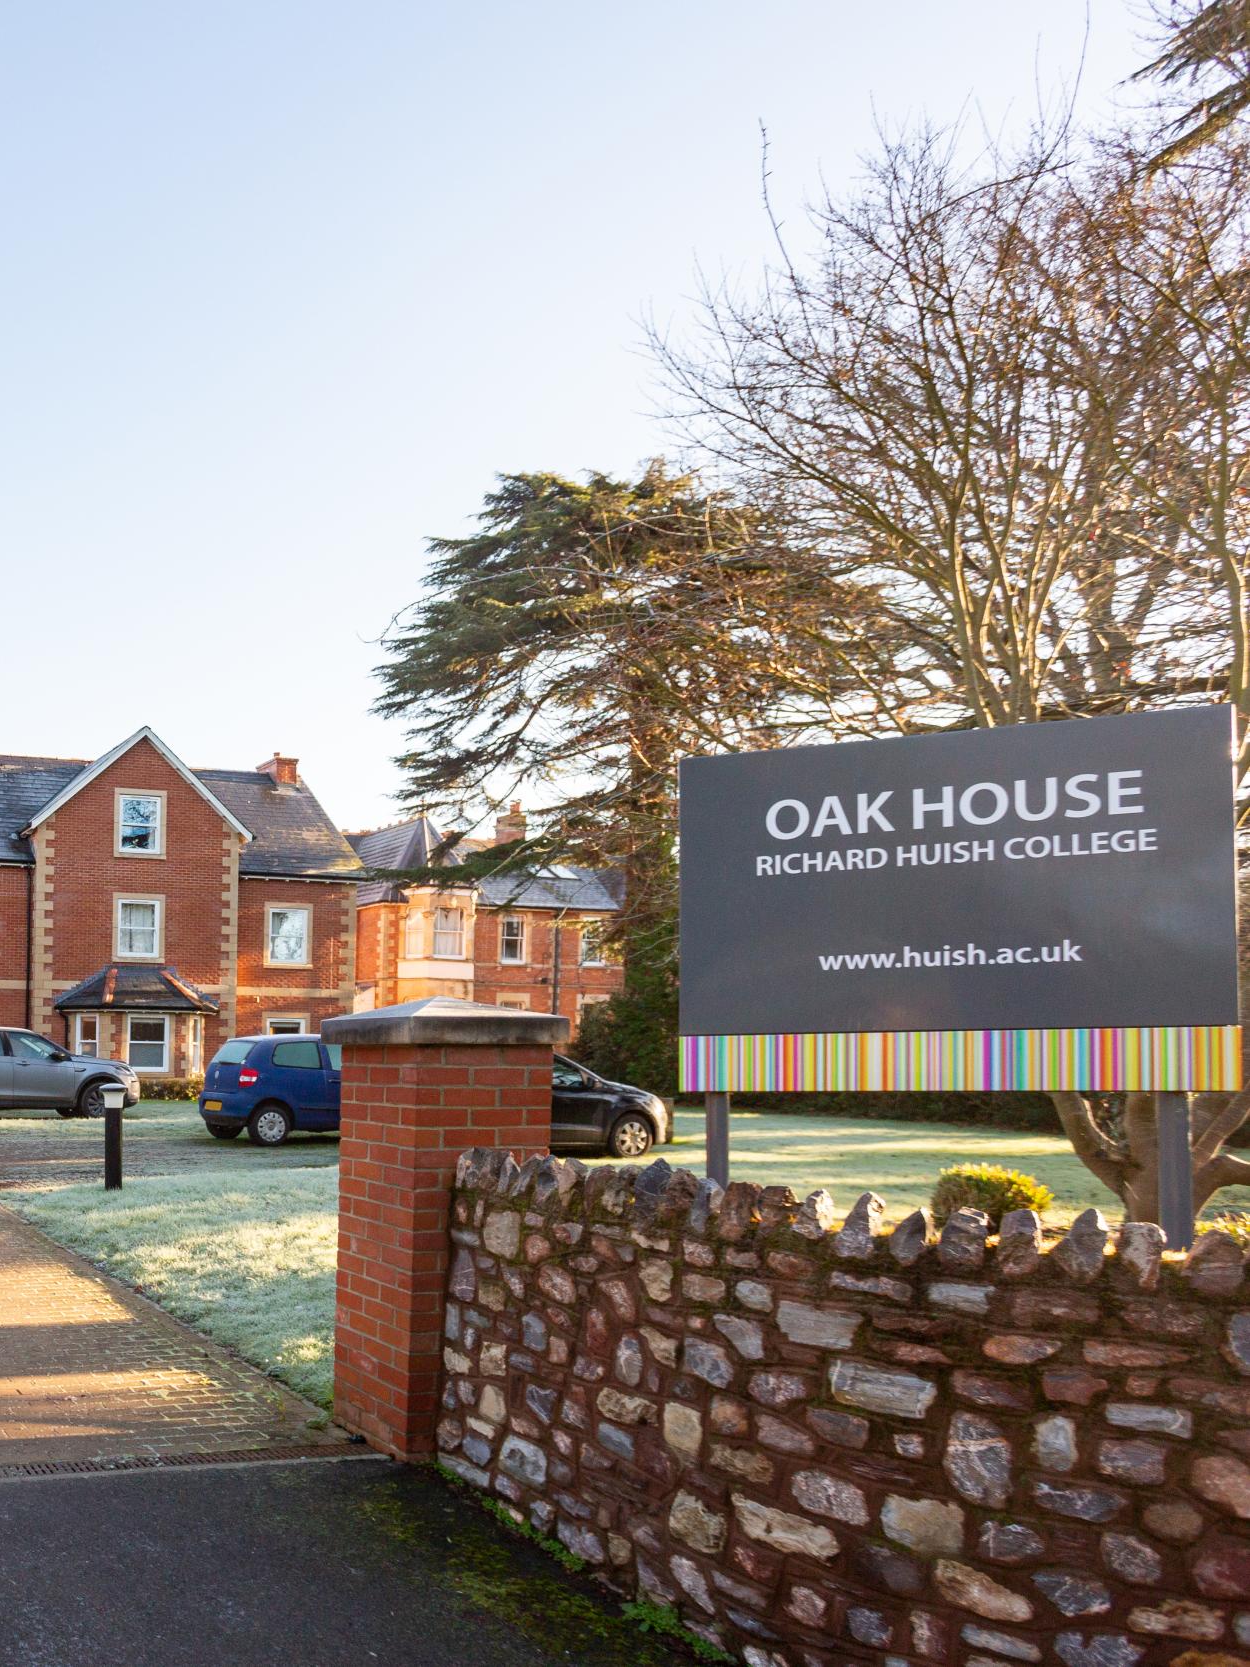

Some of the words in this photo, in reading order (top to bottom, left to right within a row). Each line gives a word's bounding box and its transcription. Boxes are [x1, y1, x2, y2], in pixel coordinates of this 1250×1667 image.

[765, 790, 896, 841] OAK
[912, 769, 1145, 830] HOUSE
[756, 846, 889, 877] RICHARD
[896, 839, 995, 867] HUISH
[1003, 828, 1159, 860] COLLEGE
[818, 939, 1083, 971] www.huish.ac.uk
